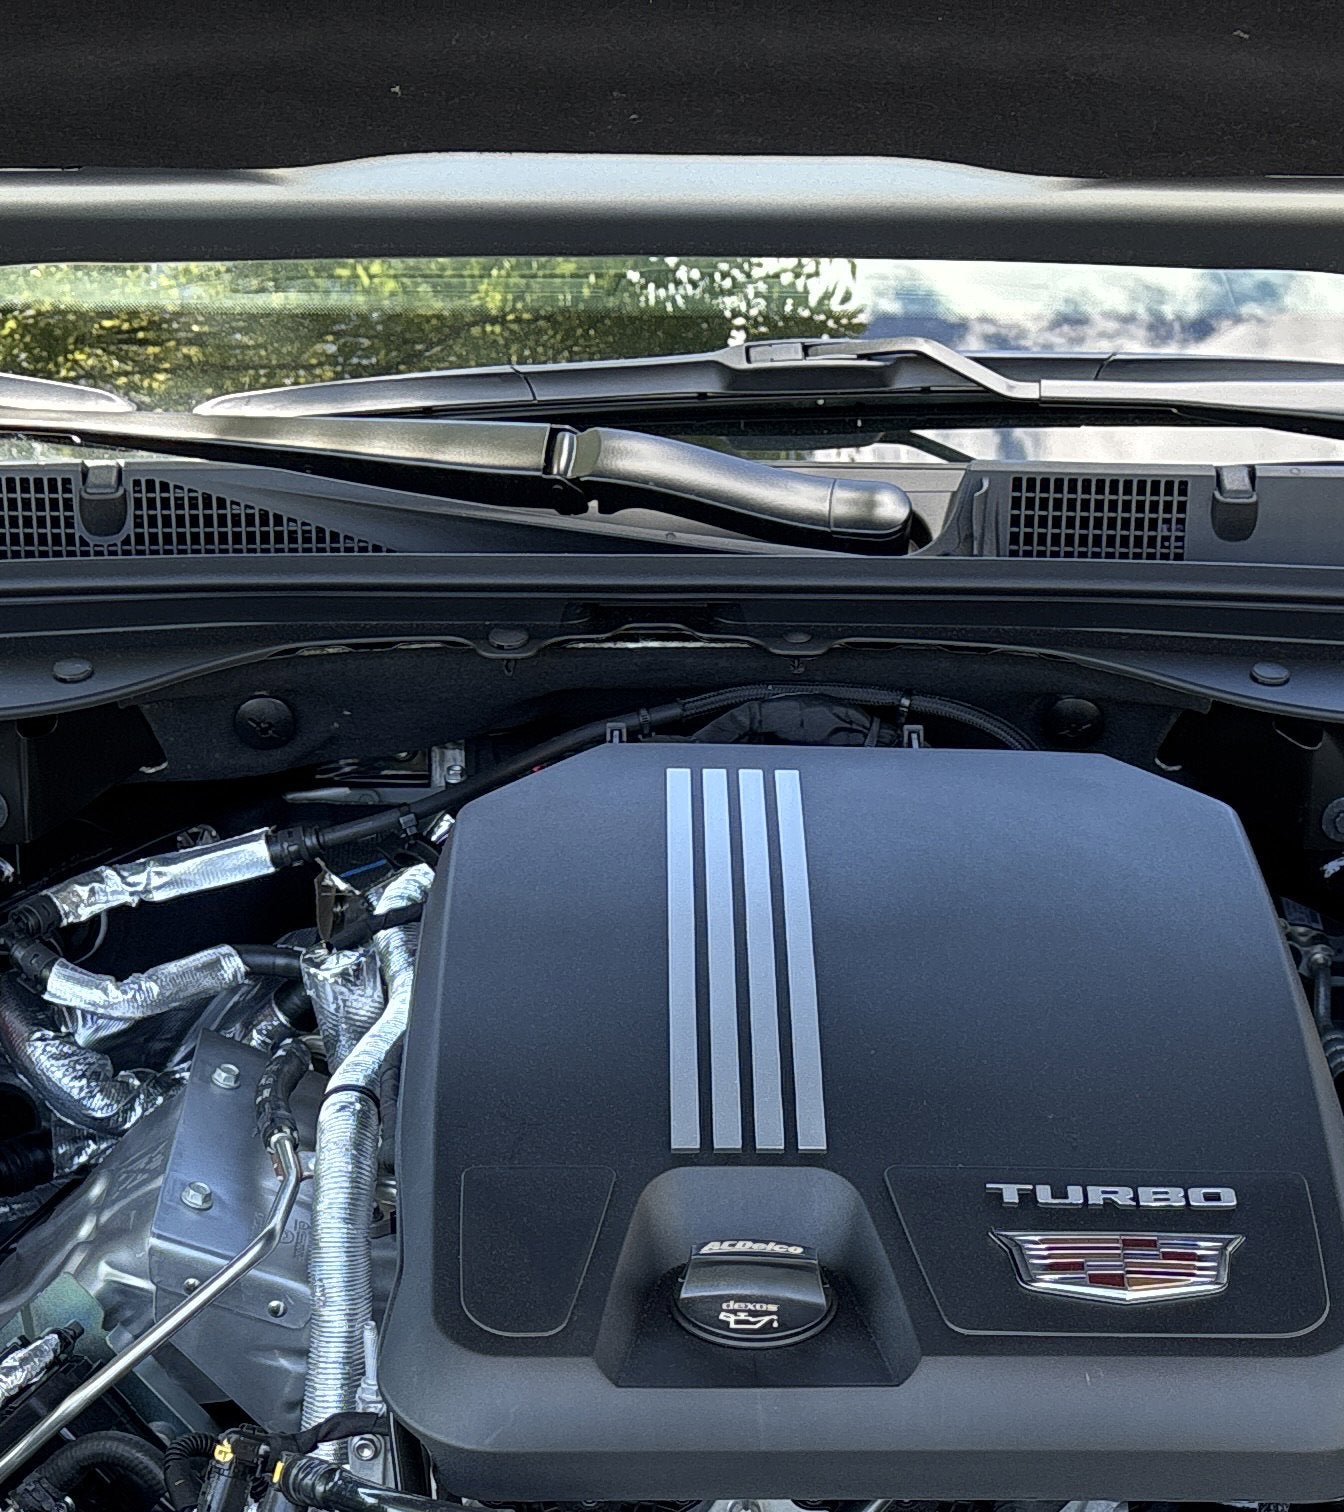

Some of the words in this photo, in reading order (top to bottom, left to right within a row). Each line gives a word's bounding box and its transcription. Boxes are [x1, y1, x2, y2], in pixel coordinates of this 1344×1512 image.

[985, 1183, 1238, 1210] TURBO
[700, 1240, 805, 1255] ACDelco
[721, 1299, 780, 1312] dexos
